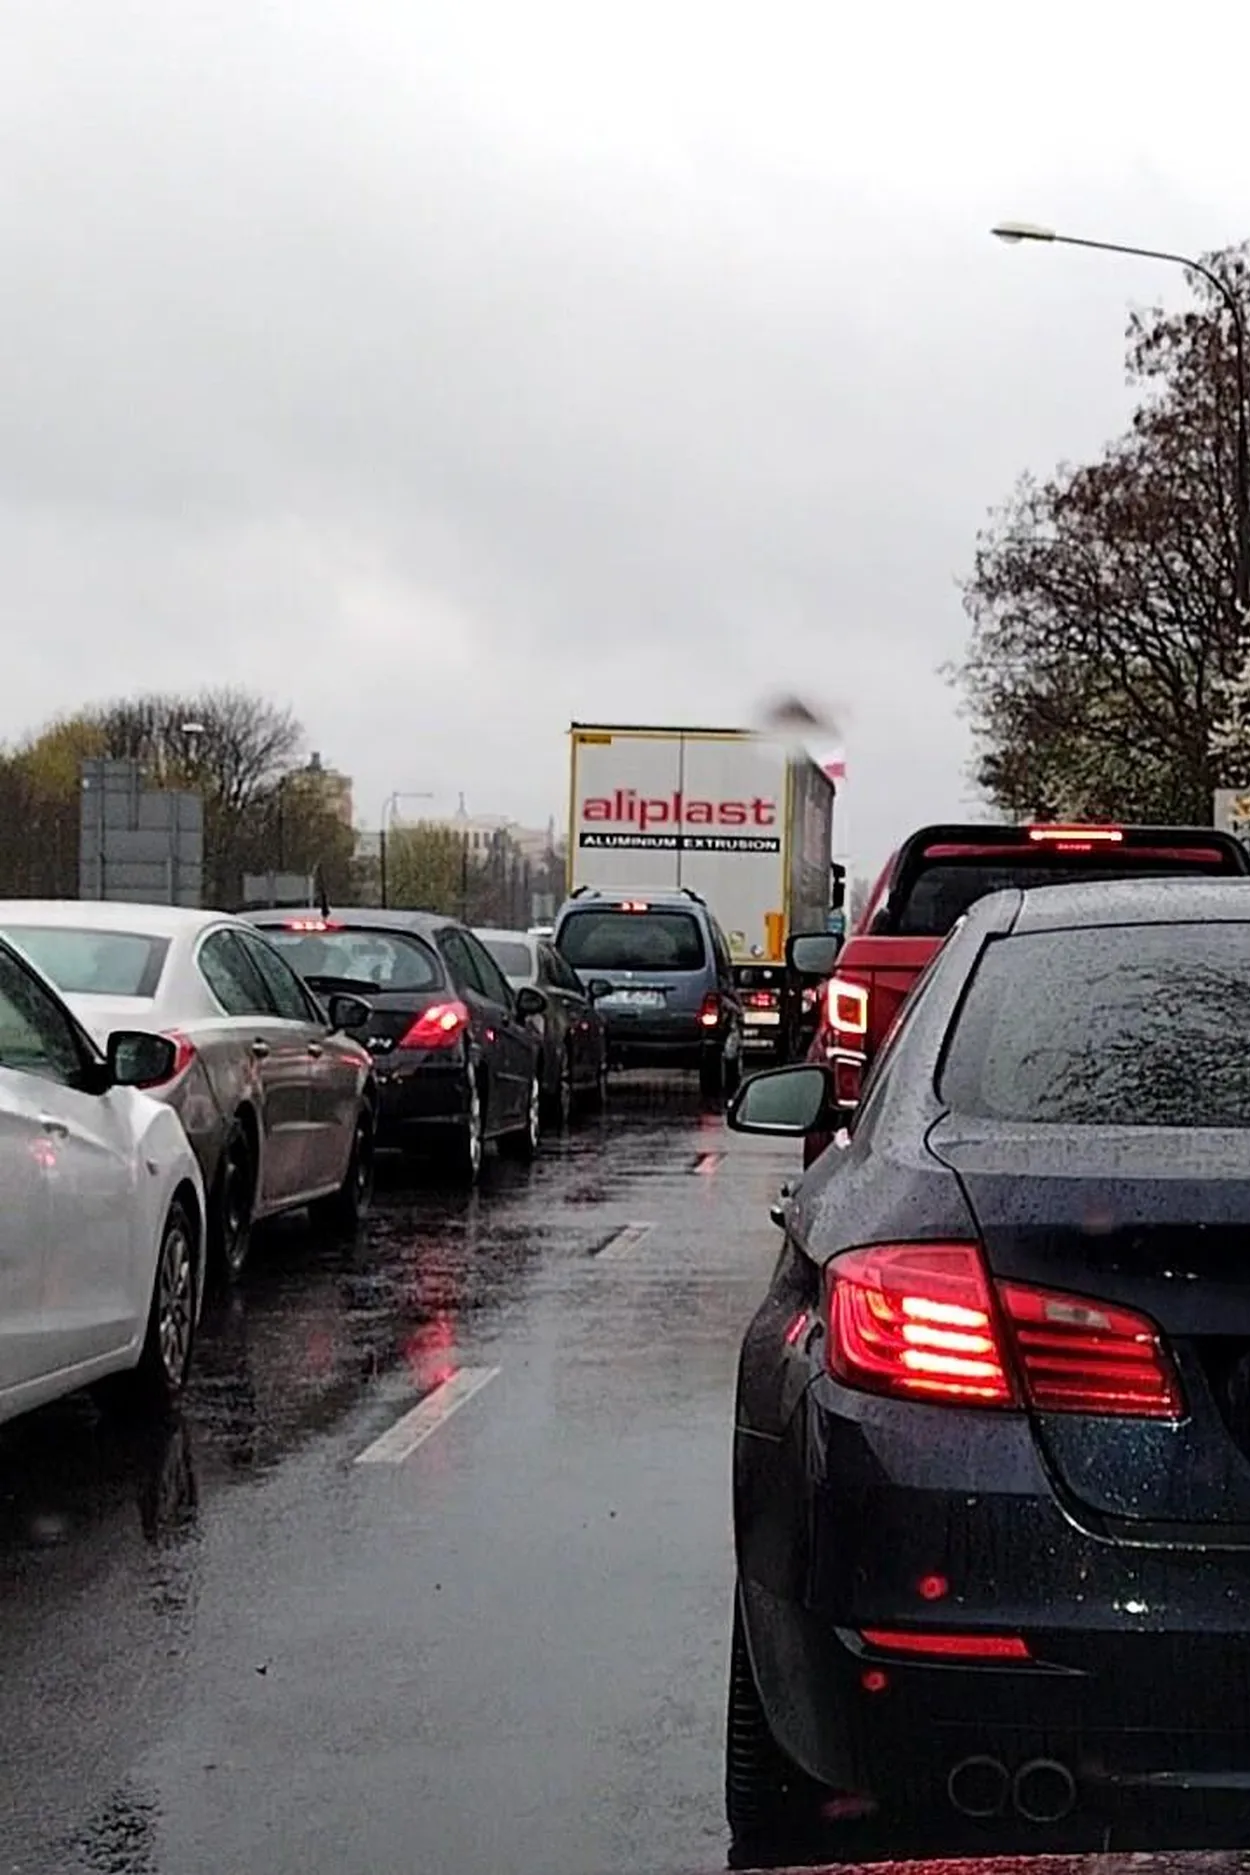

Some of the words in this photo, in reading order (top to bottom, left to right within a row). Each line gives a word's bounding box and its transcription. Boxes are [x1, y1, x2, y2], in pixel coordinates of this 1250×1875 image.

[583, 788, 776, 830] aliplast
[584, 835, 677, 848] ALUMINIUM
[683, 838, 777, 851] EXTRUSION
